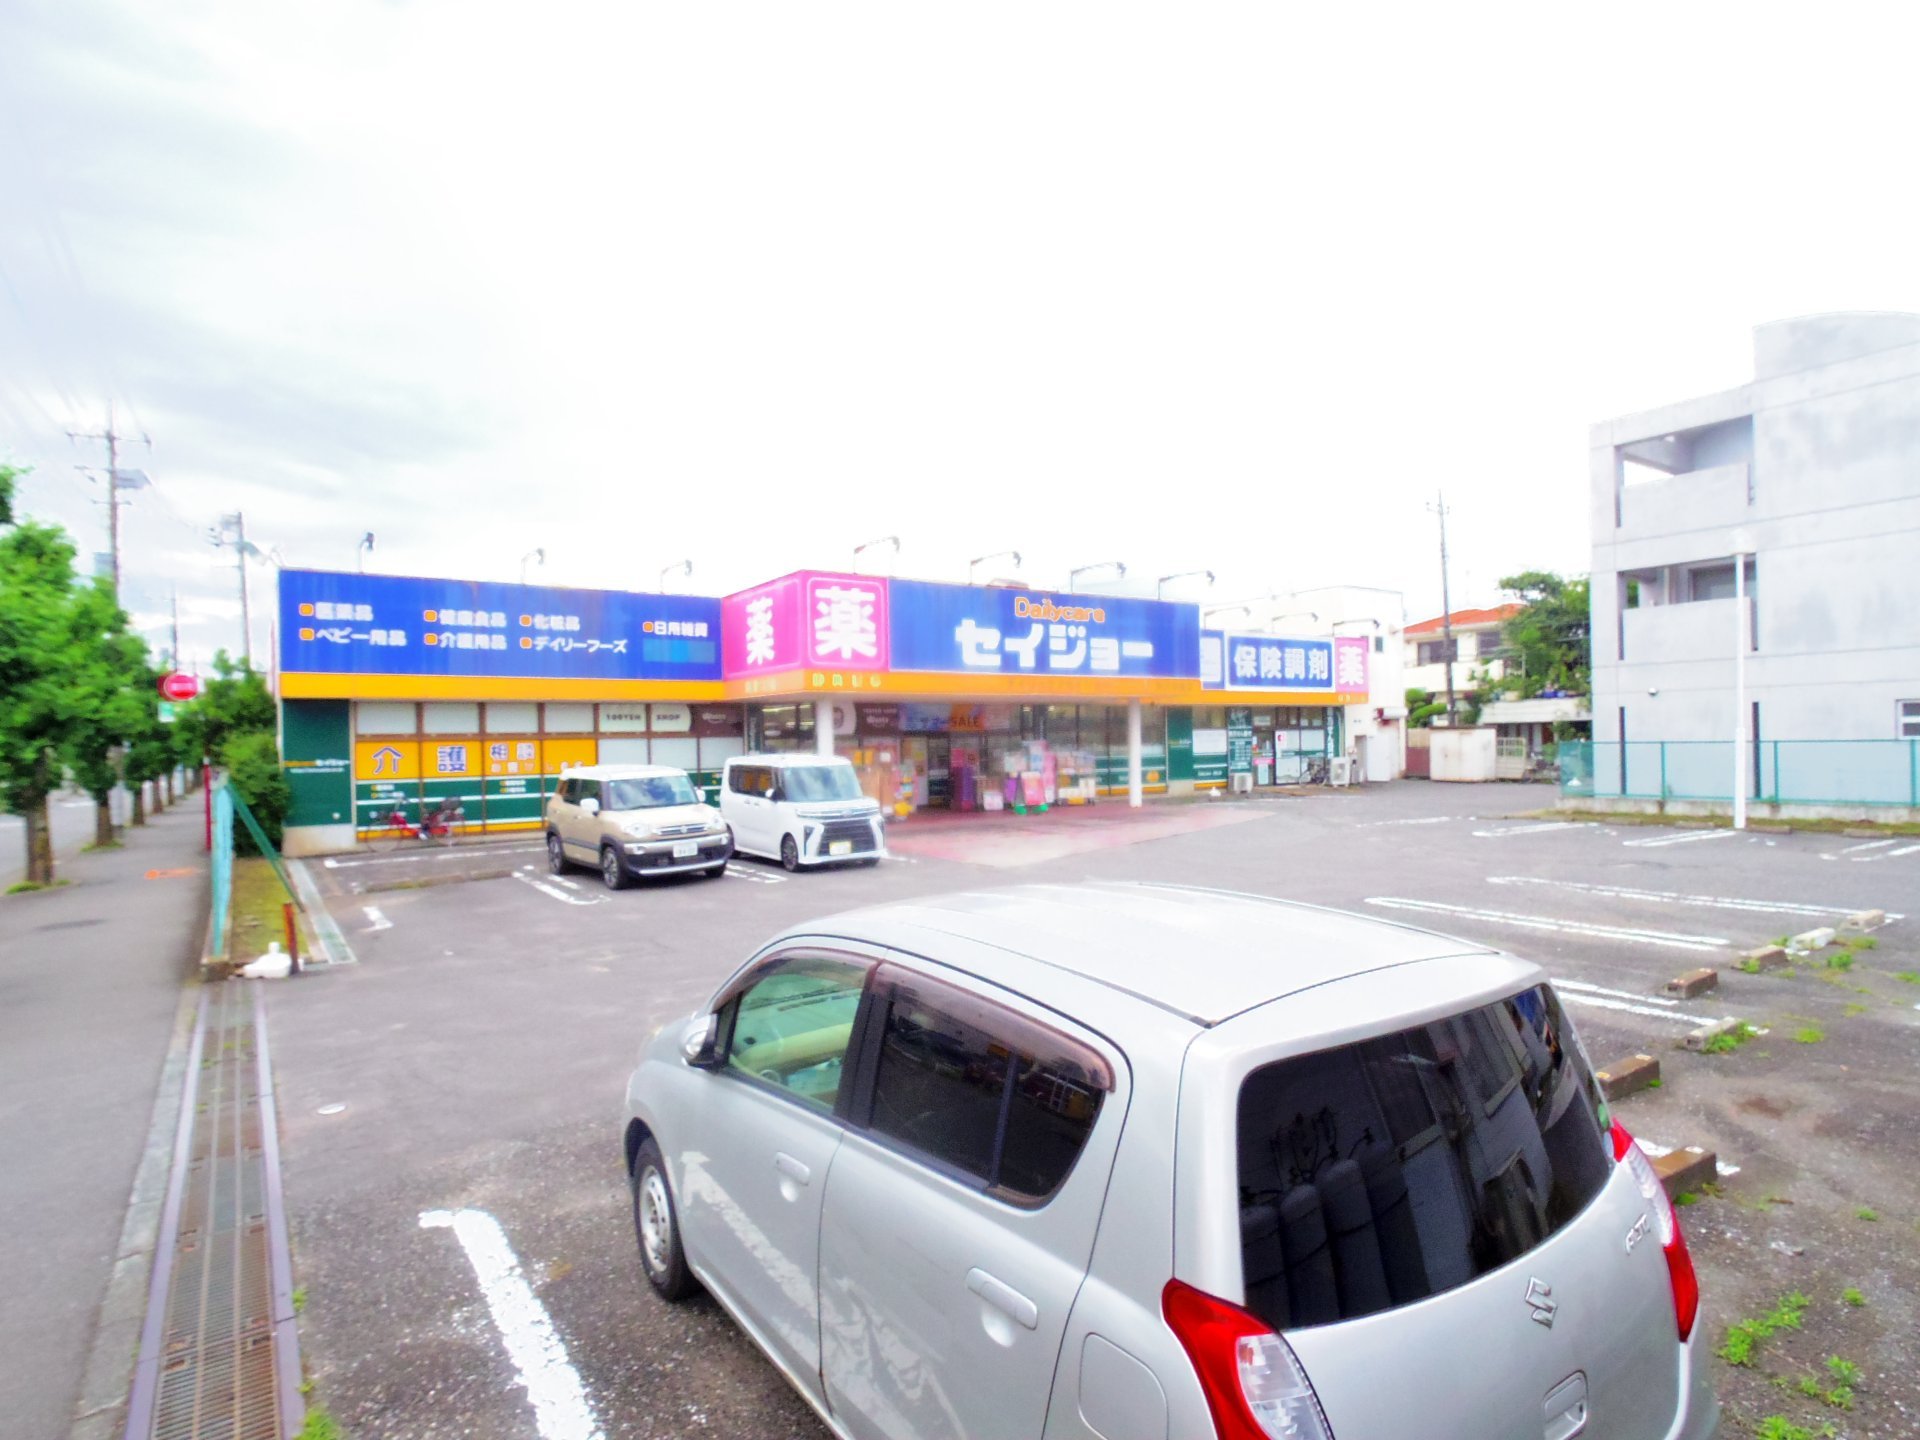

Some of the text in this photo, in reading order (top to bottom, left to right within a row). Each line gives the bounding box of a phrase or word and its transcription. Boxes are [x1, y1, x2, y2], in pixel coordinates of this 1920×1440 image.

[814, 586, 878, 659] 薬
[1014, 597, 1106, 623] Dailycare
[534, 636, 628, 653] デイリーフーズ
[746, 597, 775, 665] 薬
[955, 619, 1154, 670] セイジョー
[1234, 644, 1329, 680] 保険調剤
[1339, 646, 1364, 686] 薬
